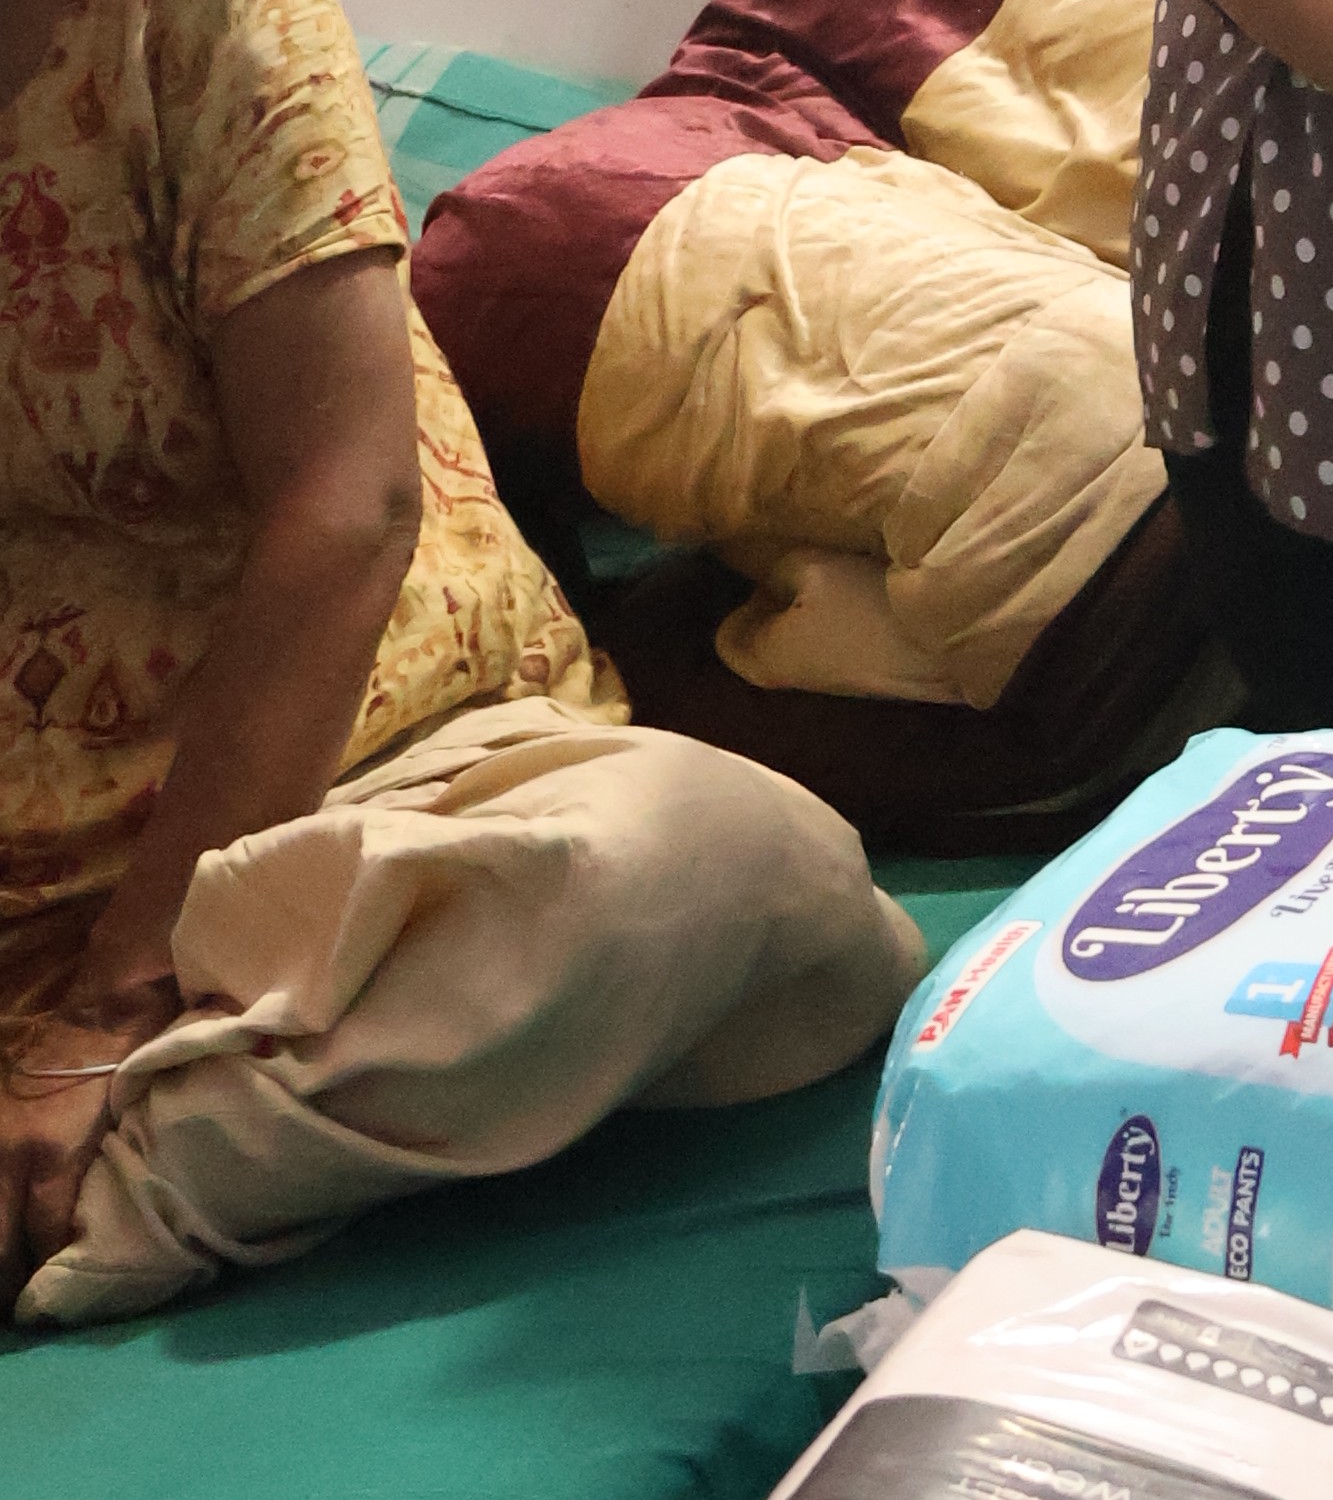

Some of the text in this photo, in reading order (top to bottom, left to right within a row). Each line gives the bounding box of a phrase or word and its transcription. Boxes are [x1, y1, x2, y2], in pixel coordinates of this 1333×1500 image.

[916, 988, 970, 1043] PAN
[1106, 1126, 1155, 1253] Liberty
[1229, 1151, 1260, 1279] ECO PANTS
